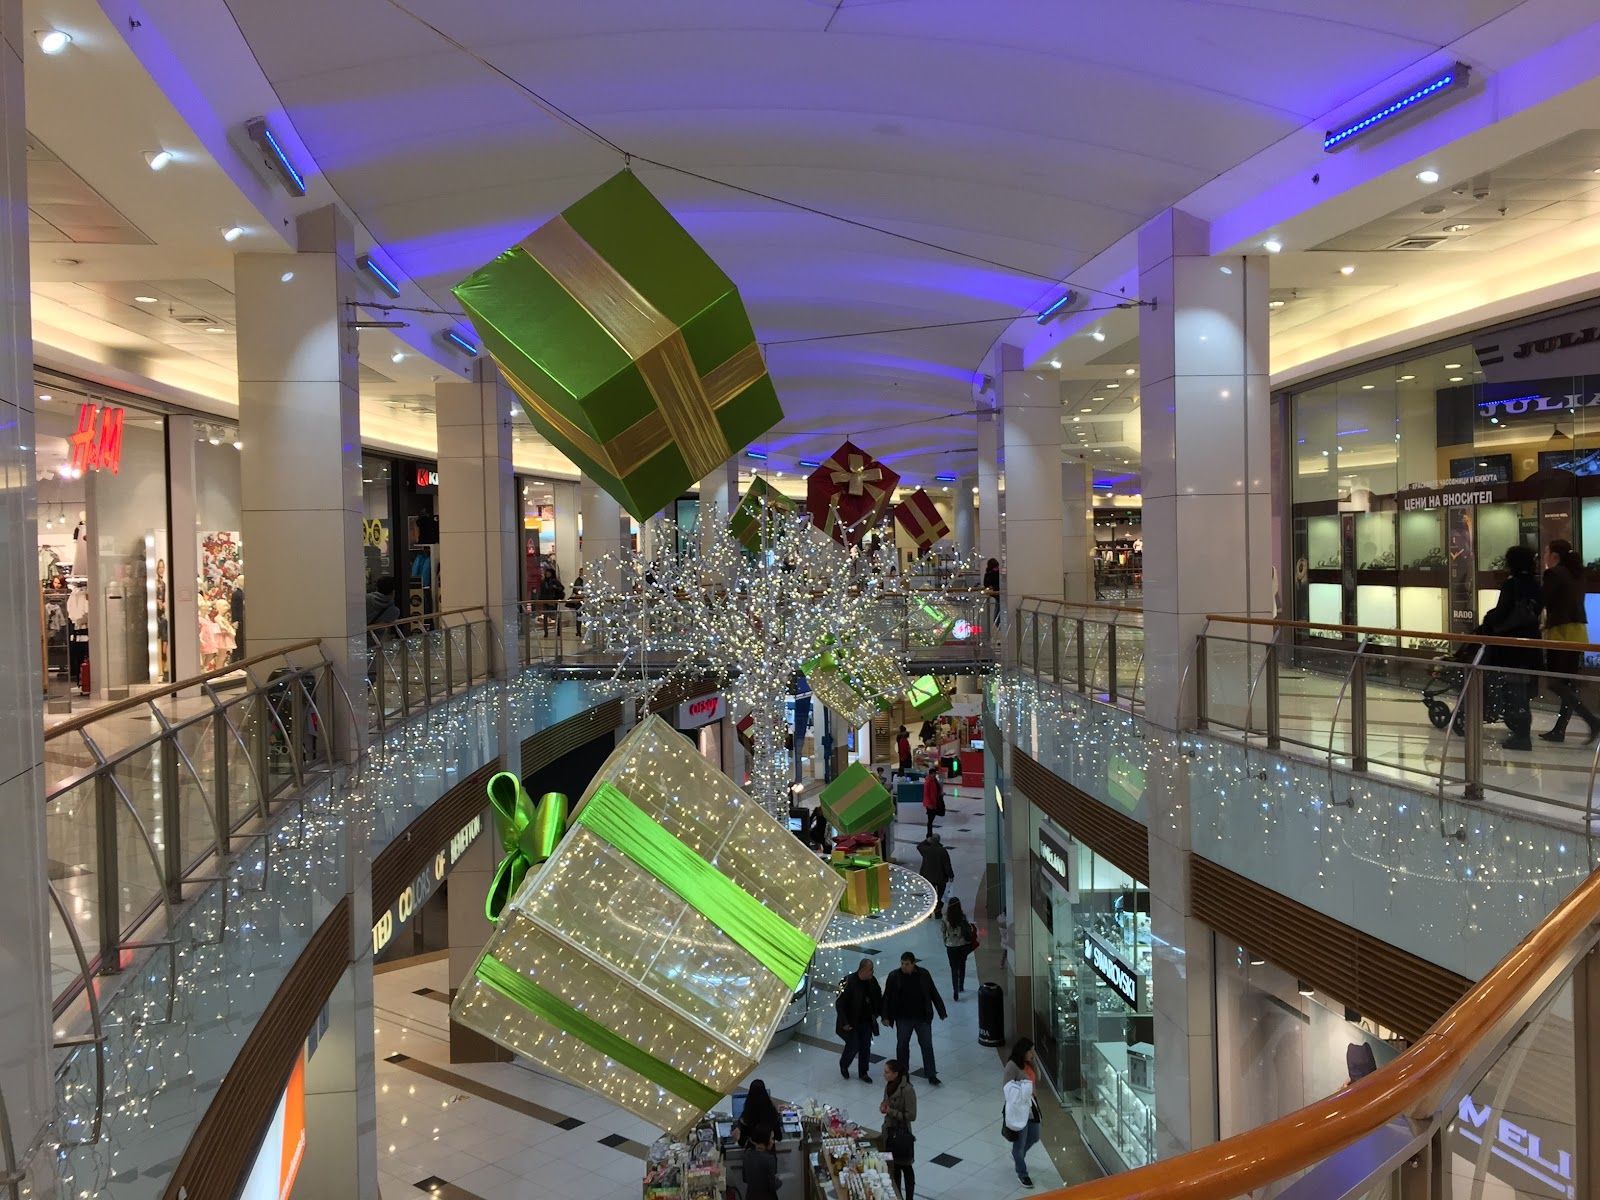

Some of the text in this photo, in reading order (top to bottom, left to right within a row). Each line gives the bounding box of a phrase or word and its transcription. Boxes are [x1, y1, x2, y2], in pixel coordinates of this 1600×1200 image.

[1513, 326, 1600, 359] JULI
[69, 404, 125, 475] H&M
[1404, 490, 1493, 511] ЦЕНИ НА ВНОСИТЕЛ
[1453, 610, 1473, 619] RADO
[434, 849, 446, 881] OF
[1093, 946, 1136, 1002] SWAROVSKI
